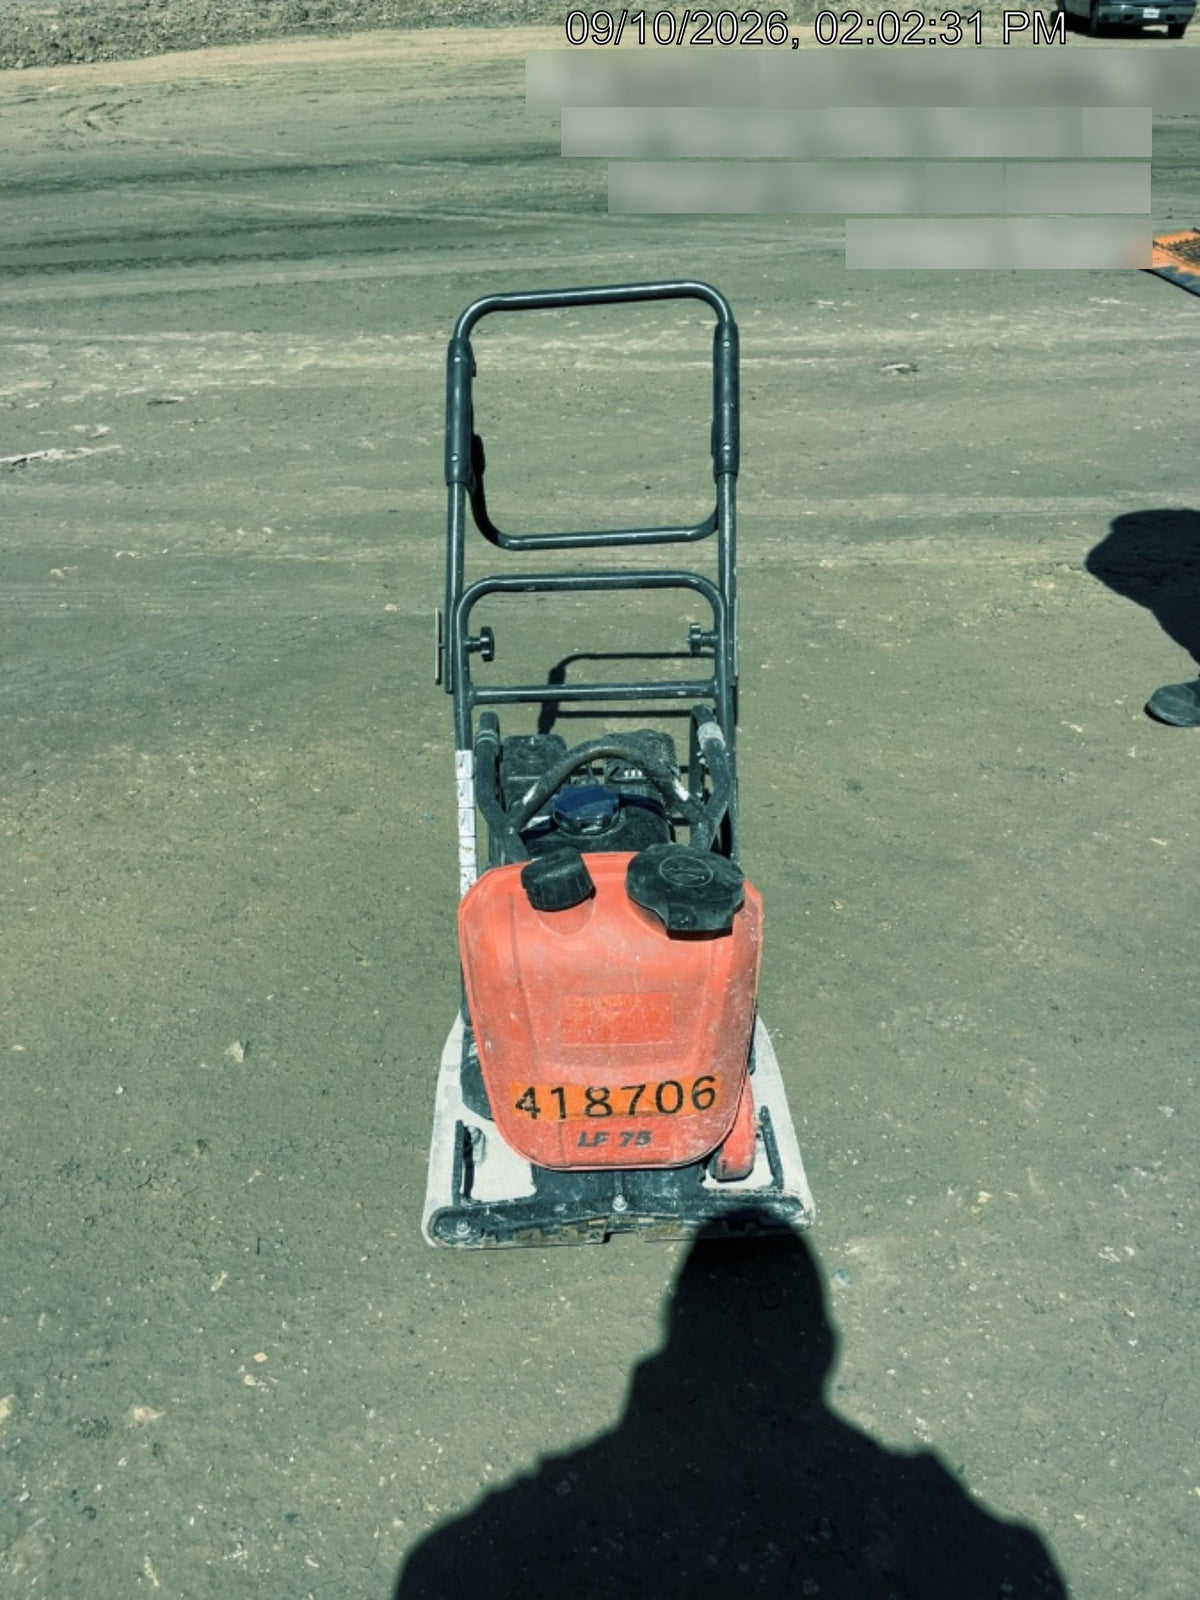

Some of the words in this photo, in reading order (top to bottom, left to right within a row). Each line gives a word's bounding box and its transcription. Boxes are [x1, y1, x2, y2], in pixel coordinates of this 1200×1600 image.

[515, 1075, 716, 1120] 418706
[577, 1130, 609, 1148] LF
[619, 1130, 652, 1148] 75
